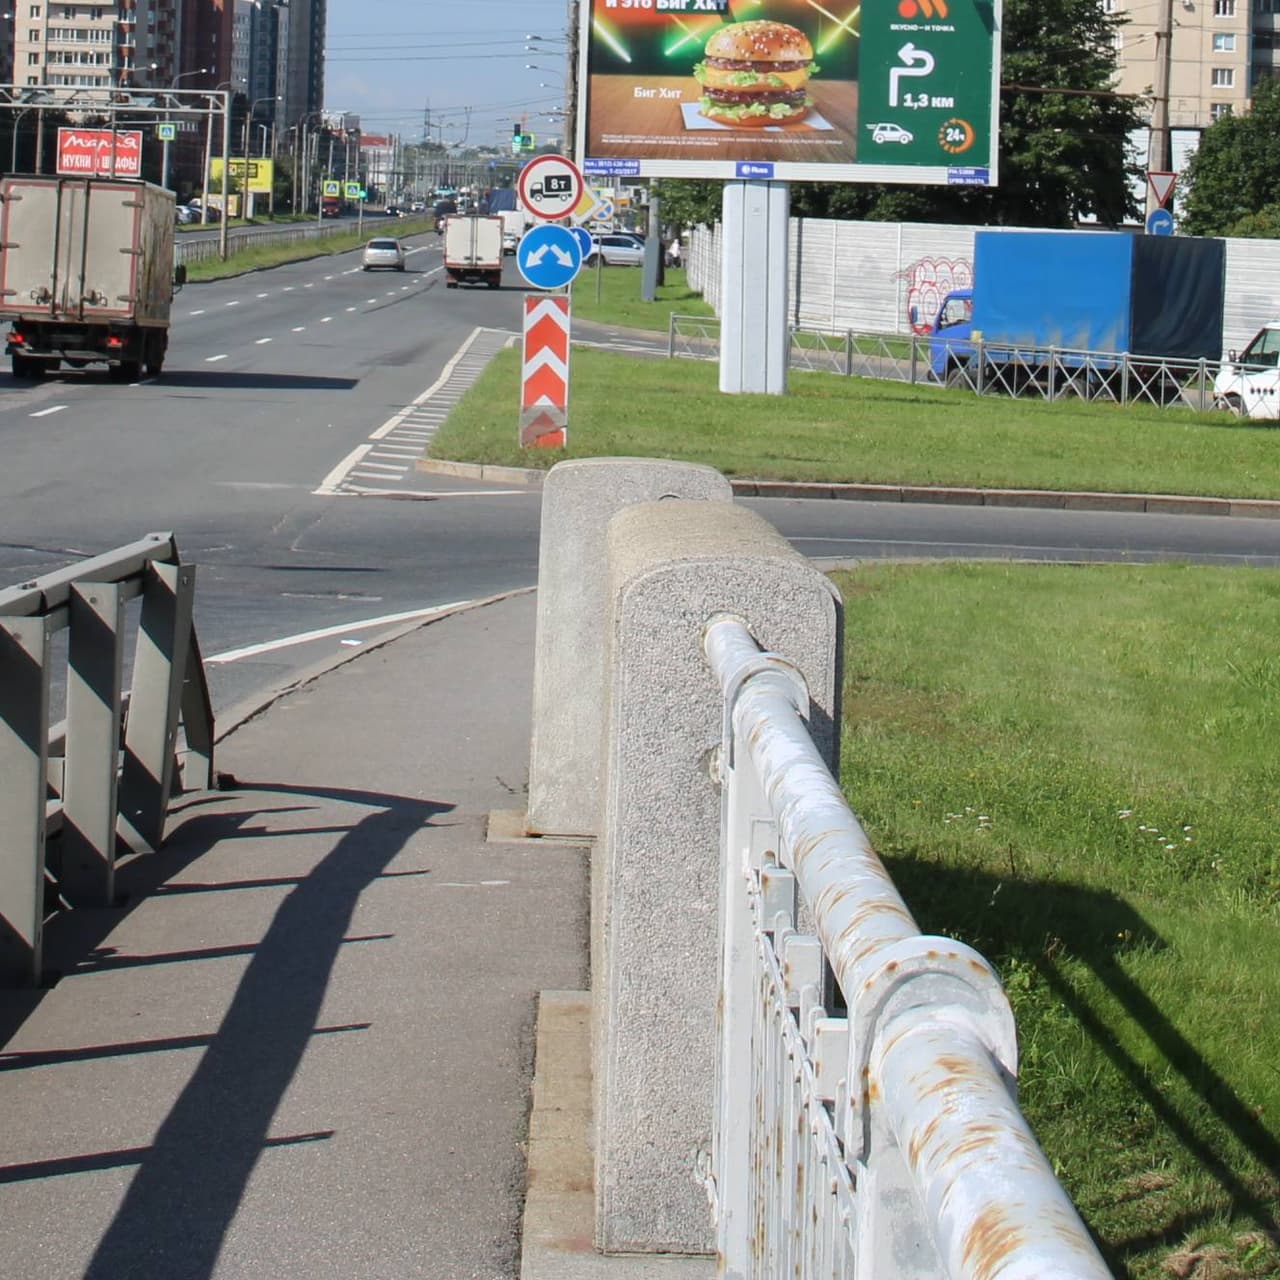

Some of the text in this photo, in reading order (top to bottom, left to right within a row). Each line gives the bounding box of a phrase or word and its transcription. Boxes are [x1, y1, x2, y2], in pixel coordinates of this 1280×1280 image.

[633, 87, 682, 98] Биг Хит
[903, 93, 929, 110] 1,3
[62, 154, 91, 168] КУХНИ
[102, 155, 137, 170] ШАФЫ
